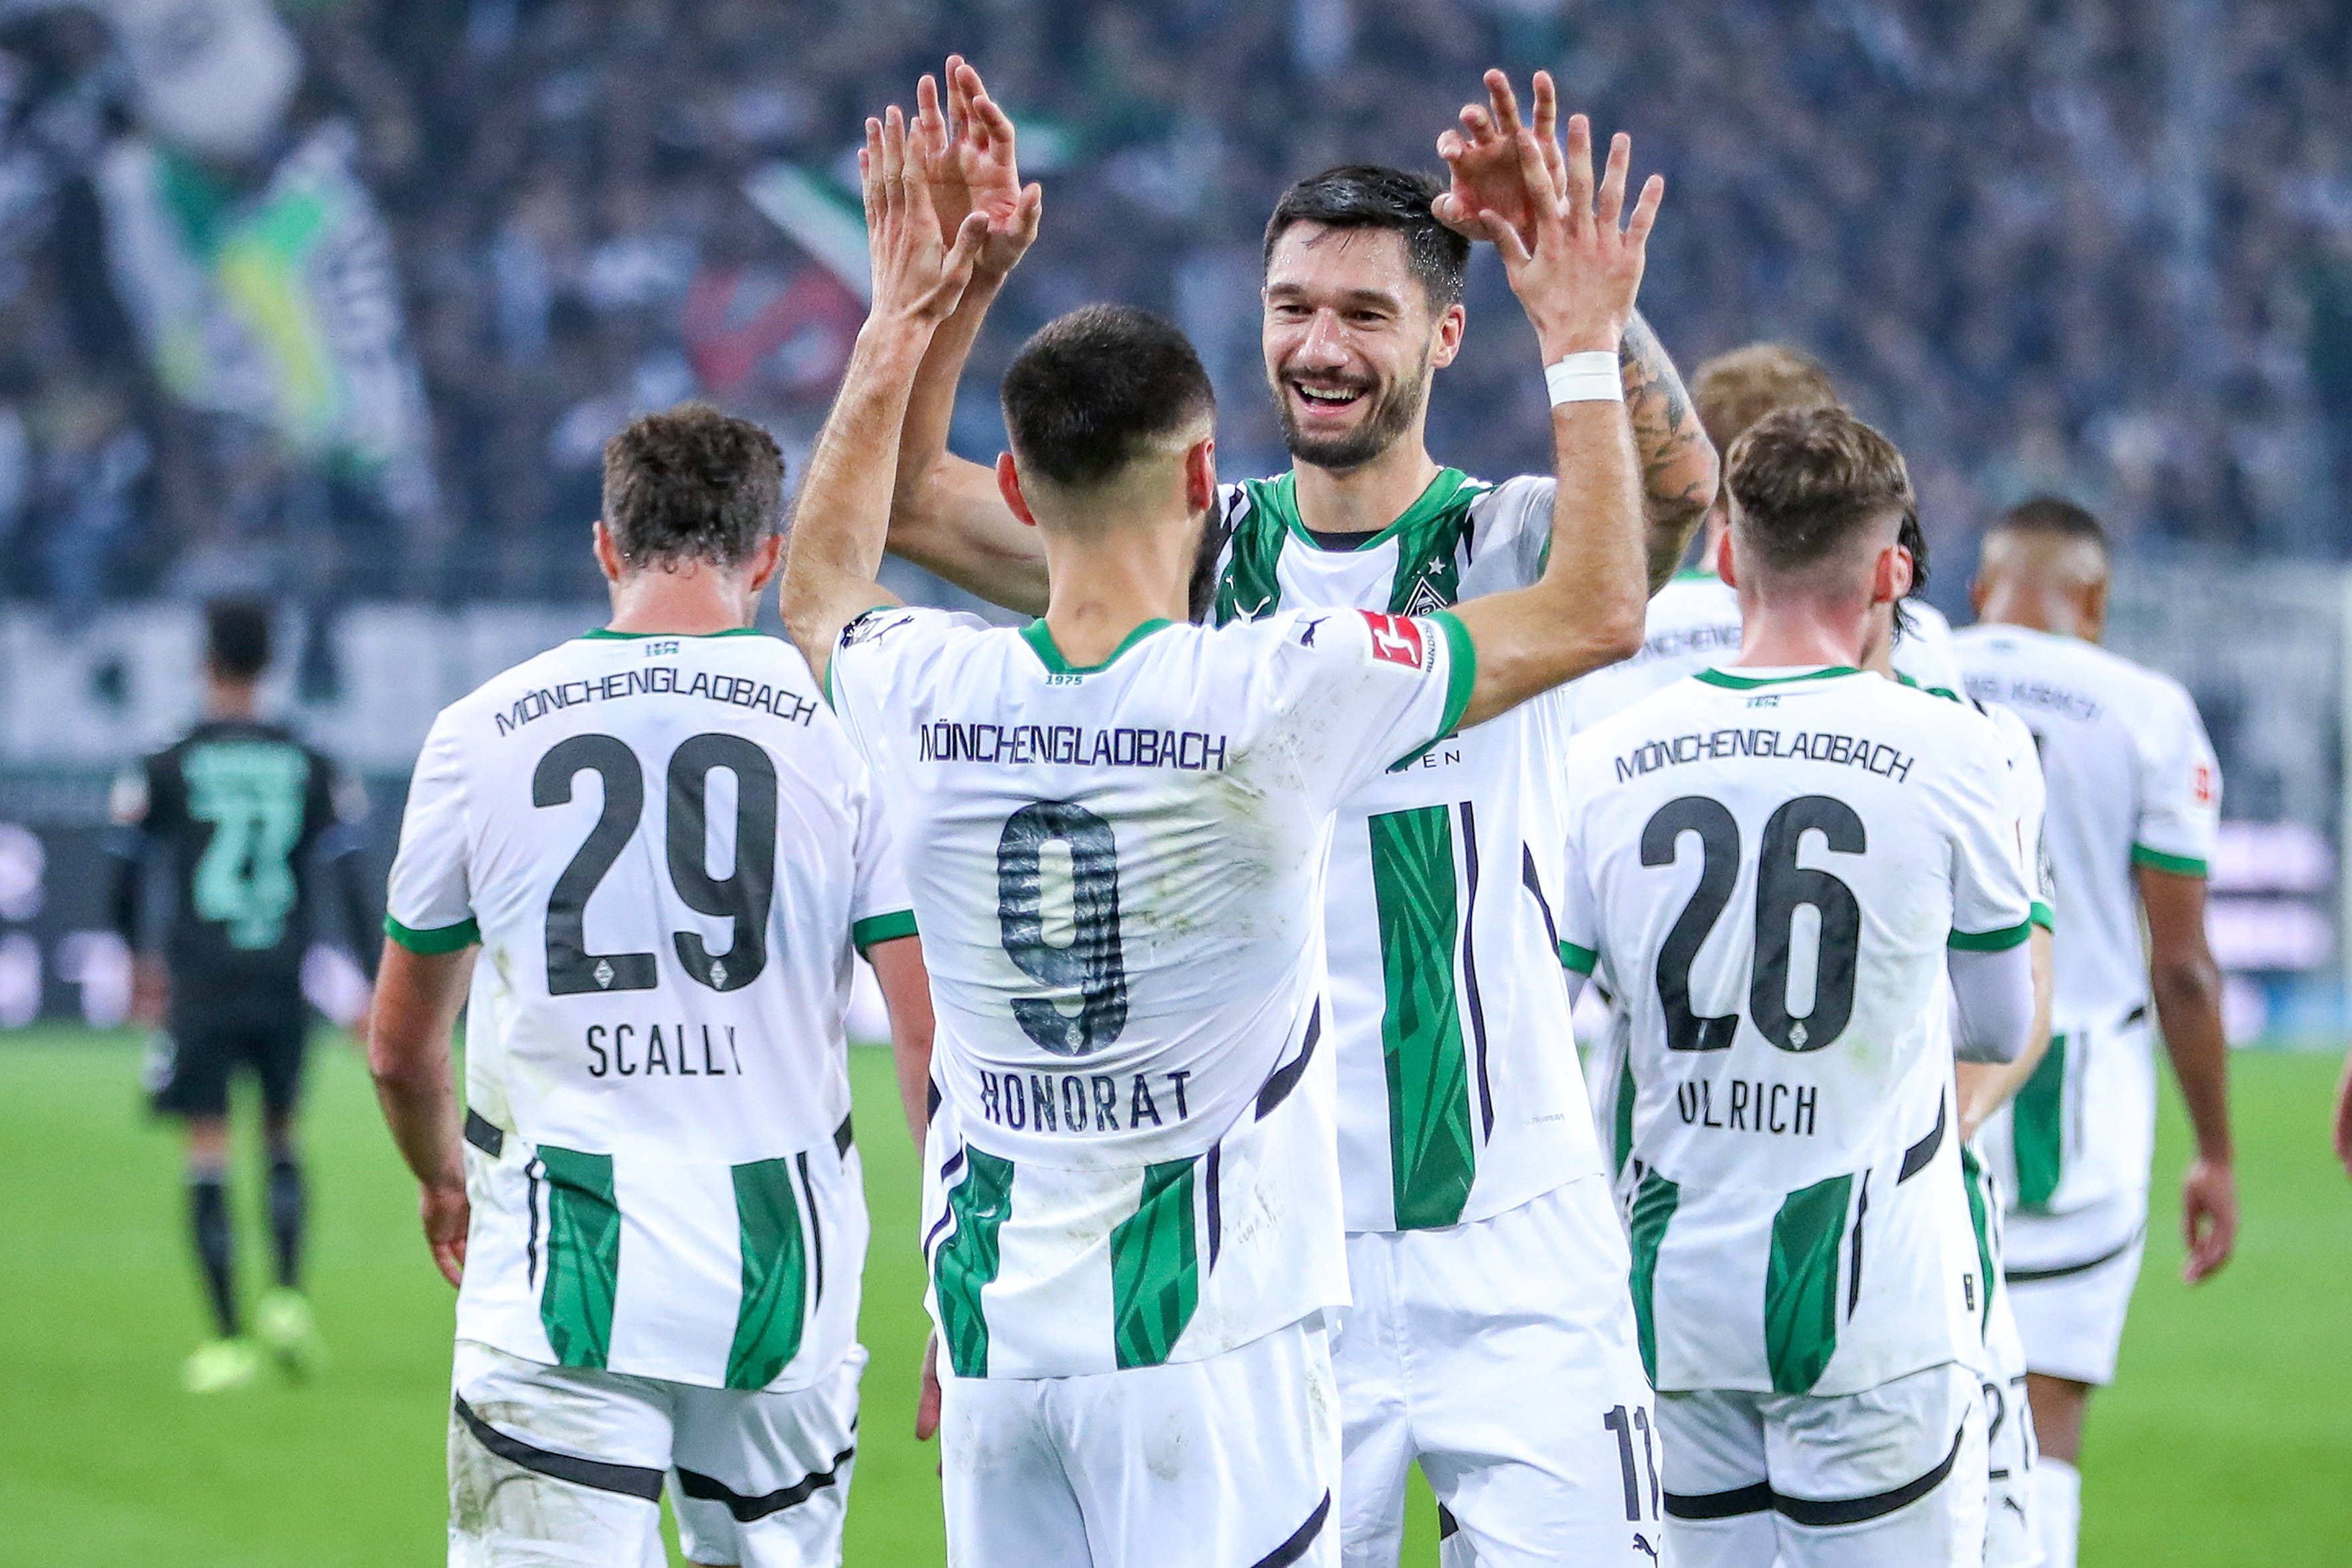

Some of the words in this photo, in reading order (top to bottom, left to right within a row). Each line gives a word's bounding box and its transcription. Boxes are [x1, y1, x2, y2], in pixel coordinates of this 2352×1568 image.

[495, 667, 818, 737] MÖNCHENGLADBACH
[1045, 674, 1083, 685] 1975
[920, 718, 1227, 771] MÖNCHENGLADBACH
[1615, 729, 1915, 784] MÖNCHENGLADBACH
[532, 733, 778, 996] 29
[997, 800, 1129, 1057] 9
[1641, 795, 1866, 1054] 26
[980, 1069, 1191, 1132] HONORAT
[1677, 1079, 1818, 1136] ULRICH
[1603, 1405, 1660, 1522] 11
